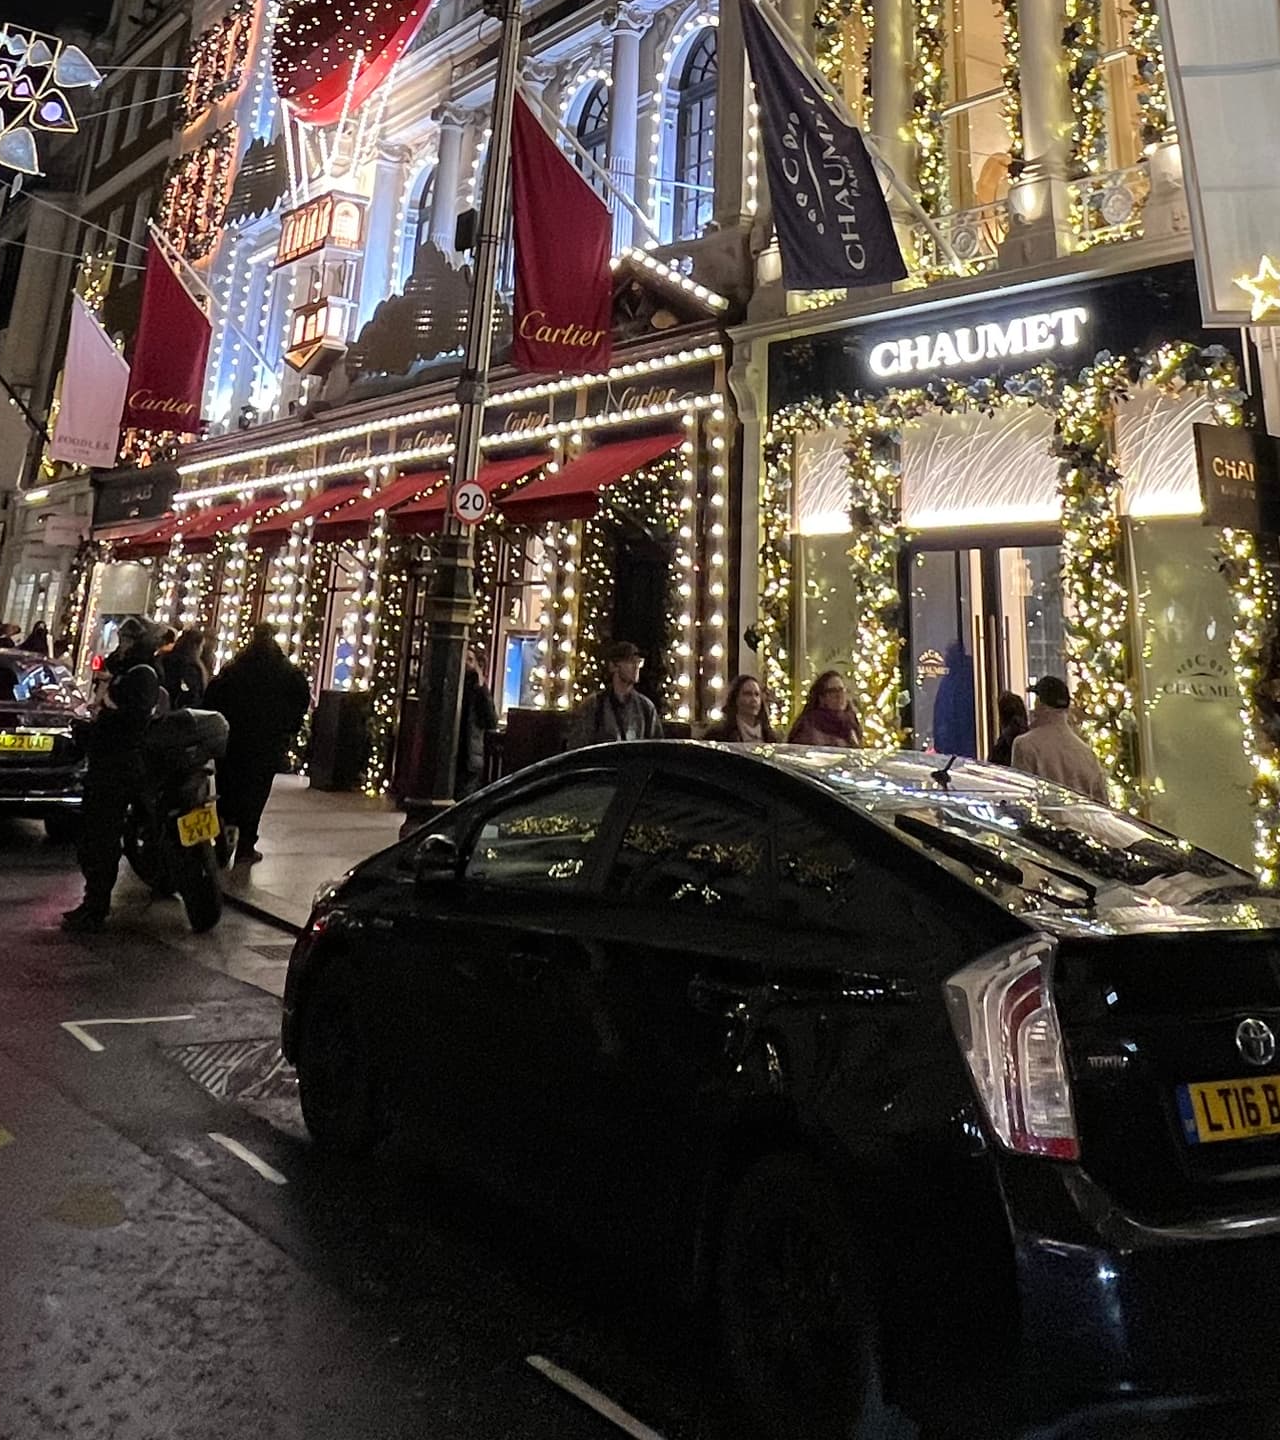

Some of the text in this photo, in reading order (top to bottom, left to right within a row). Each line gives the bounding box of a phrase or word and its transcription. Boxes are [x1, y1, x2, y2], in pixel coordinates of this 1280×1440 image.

[519, 310, 607, 348] Cartier
[868, 306, 1088, 377] CHAUMET
[128, 388, 196, 415] Cartier
[459, 492, 485, 511] 20
[1199, 1087, 1262, 1132] LT16
